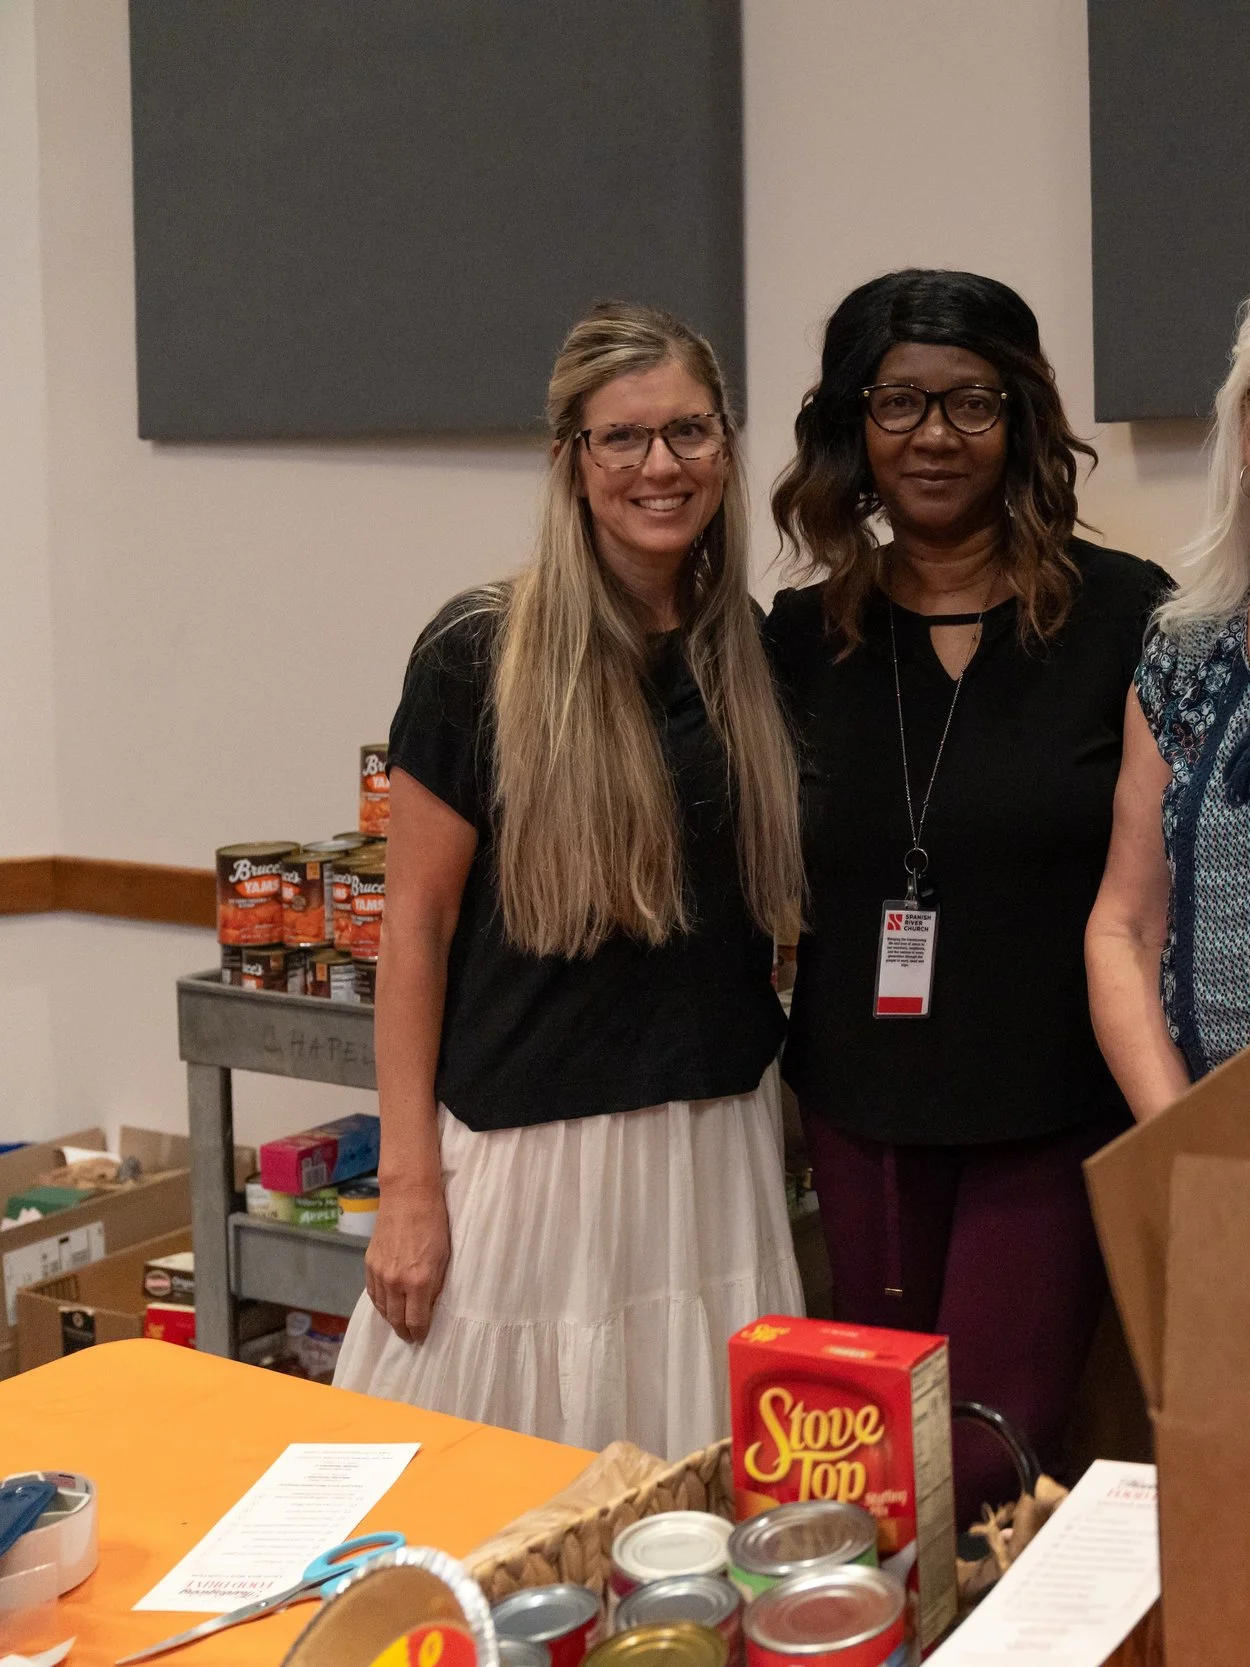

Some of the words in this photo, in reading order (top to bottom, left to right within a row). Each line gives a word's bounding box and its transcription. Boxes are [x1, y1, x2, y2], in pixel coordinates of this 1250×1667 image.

[228, 858, 282, 883] Bruce'
[244, 878, 281, 893] YAMS
[351, 875, 384, 896] Bruce
[744, 1387, 884, 1482] Stove
[796, 1448, 866, 1503] Top
